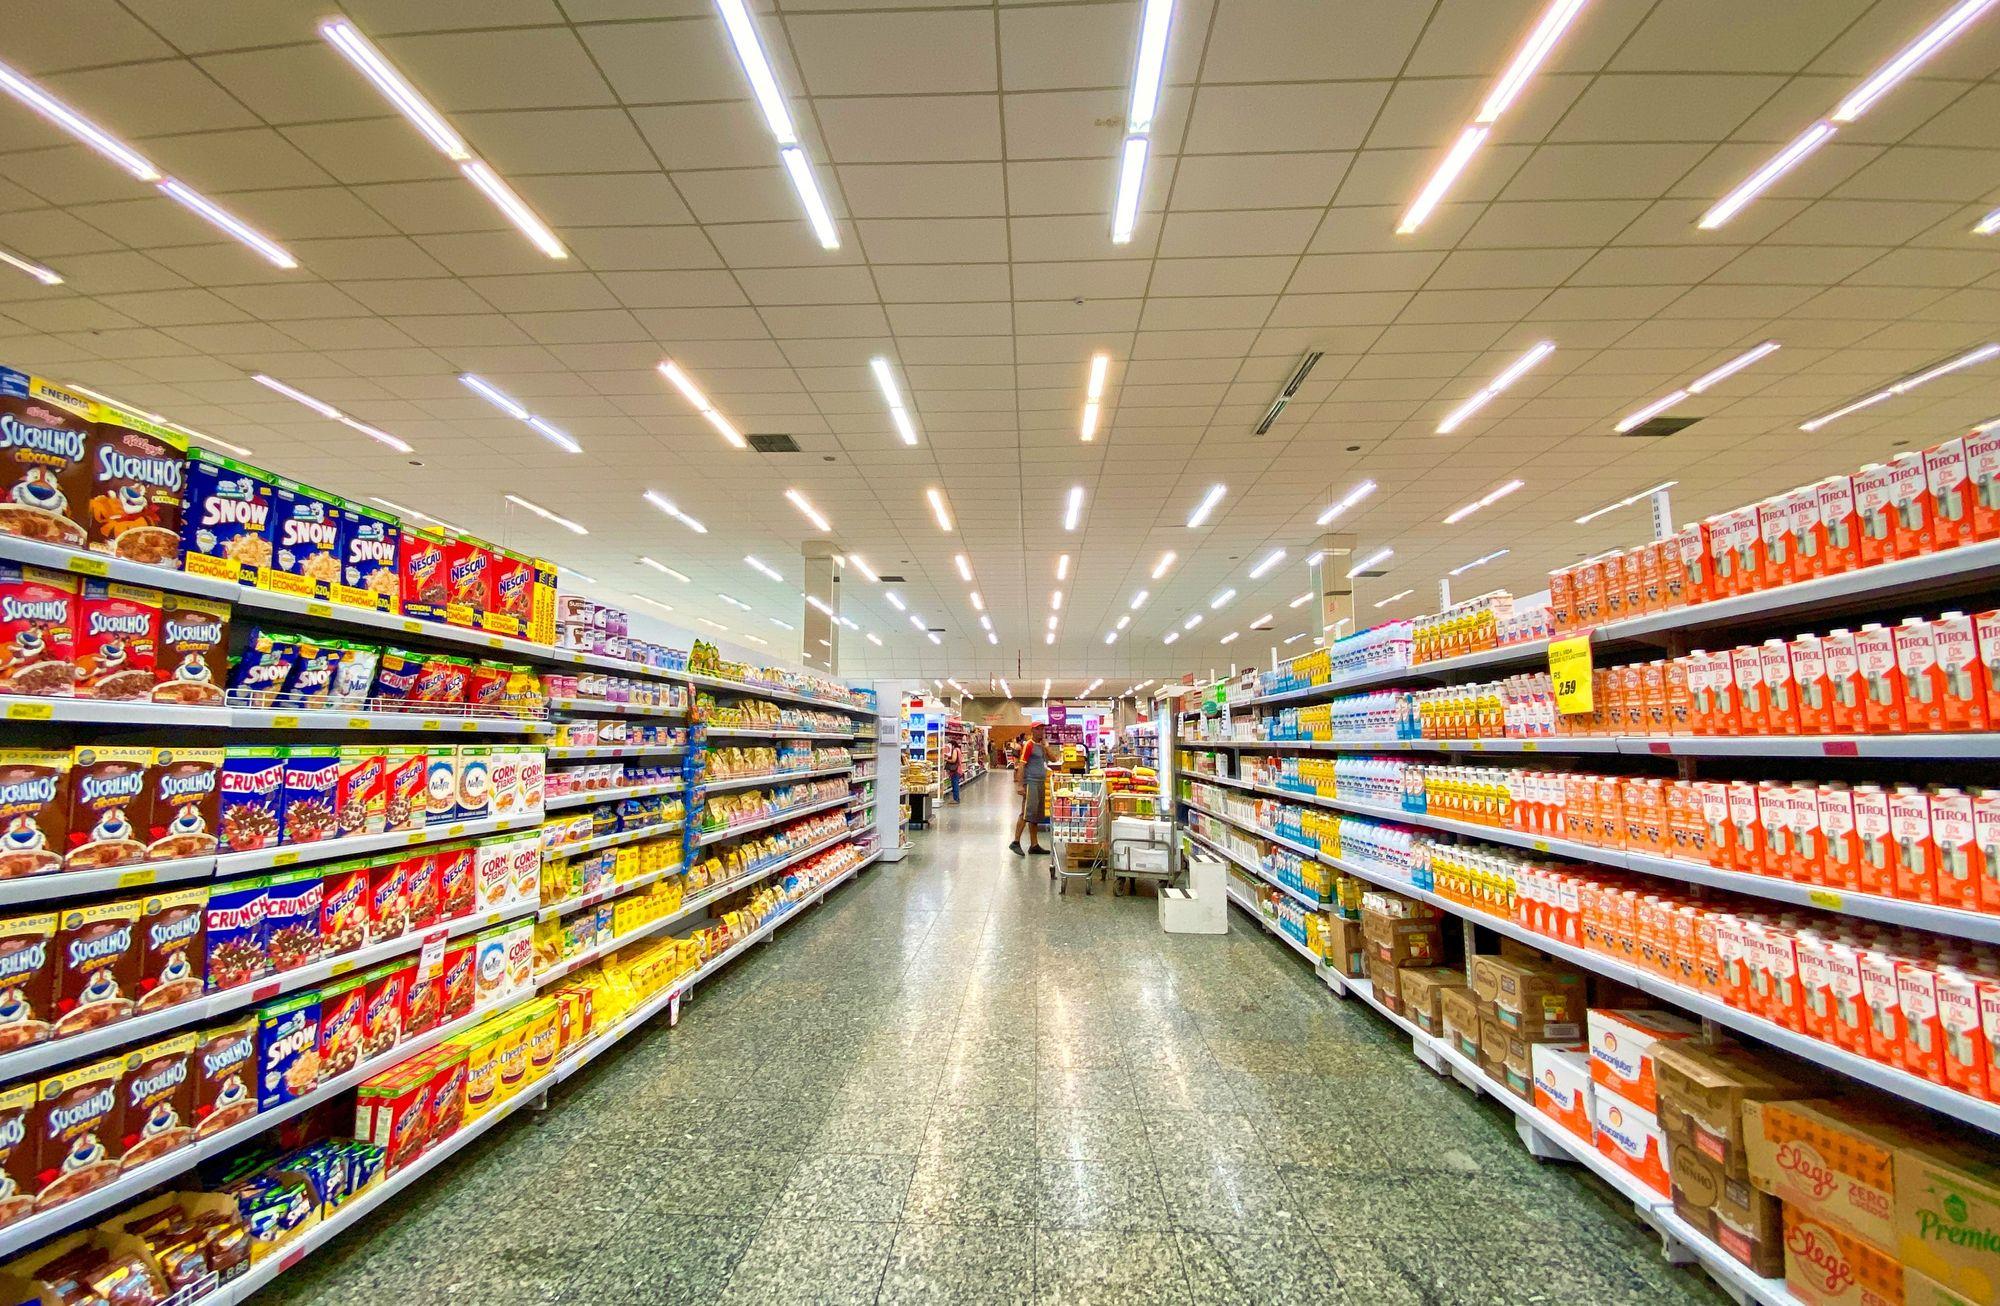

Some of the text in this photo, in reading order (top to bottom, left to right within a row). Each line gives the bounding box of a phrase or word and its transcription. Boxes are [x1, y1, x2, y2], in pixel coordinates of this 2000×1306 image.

[0, 416, 88, 462] SUCRILHOS
[99, 445, 185, 493] SUCRILHOS
[1926, 452, 1964, 471] TIROL
[1889, 466, 1922, 484] TIROL
[1820, 489, 1850, 505] TIROL
[1854, 478, 1889, 495] TIROL
[202, 499, 270, 526] SNOW
[1761, 509, 1786, 523] TIROL
[1788, 499, 1818, 516] TIROL
[283, 519, 338, 546] SNOW
[1711, 527, 1734, 540] TIROL
[1733, 518, 1757, 532] TIROL
[348, 538, 396, 564] SNOW
[1680, 535, 1701, 548] TIROL
[409, 549, 442, 576] NESCAU
[450, 555, 487, 582] NESCAU
[498, 570, 531, 595] NESCAU
[2, 596, 68, 624] SUCRILHOS
[89, 611, 151, 636] SUCRILHOS
[165, 620, 222, 645] SUCRILHOS
[1857, 642, 1891, 655] TIROL
[1897, 636, 1933, 650] TIROL
[1936, 631, 1972, 645] TIROL
[1763, 654, 1786, 666] TIROL
[1792, 651, 1822, 663] TIROL
[1824, 646, 1854, 659] TIROL
[243, 664, 293, 685] SNOW
[1708, 661, 1730, 672] TIROL
[1735, 659, 1758, 670] TIROL
[417, 671, 446, 695] NESCAU
[222, 767, 283, 792] CRUNCH
[285, 765, 339, 789] CRUNCH
[347, 764, 381, 792] NESCAU
[395, 761, 424, 788] NESCAU
[492, 764, 516, 782] CORN
[521, 763, 542, 780] CORN
[82, 770, 145, 802] SUCRILHOS
[161, 769, 216, 800] SUCRILHOS
[1704, 793, 1725, 805] TIROL
[1730, 794, 1756, 807] TIROL
[1761, 796, 1786, 809] TIROL
[1786, 799, 1816, 812] TIROL
[1819, 801, 1850, 814] TIROL
[1856, 803, 1886, 817] TIROL
[1891, 805, 1927, 820] TIROL
[1932, 808, 1971, 822] TIROL
[482, 854, 508, 876] CORN
[514, 848, 537, 869] CORN
[443, 855, 472, 889] NESCAU
[325, 876, 366, 921] NESCAU
[374, 870, 407, 908] NESCAU
[208, 895, 268, 930] CRUNCH
[267, 886, 323, 918] CRUNCH
[151, 911, 201, 950] SUCRILHOS
[1718, 928, 1741, 943] TIROL
[69, 925, 132, 970] SUCRILHOS
[509, 937, 530, 961] CORN
[1742, 936, 1766, 951] TIROL
[1766, 943, 1790, 959] TIROL
[444, 952, 473, 989] NESCAU
[1800, 952, 1825, 969] TIROL
[1828, 960, 1857, 978] TIROL
[1861, 969, 1895, 987] TIROL
[1899, 978, 1933, 997] TIROL
[366, 981, 400, 1025] NESCAU
[1940, 988, 1974, 1009] TIROL
[323, 996, 361, 1039] NESCAU
[267, 1023, 317, 1069] SNOW
[531, 1025, 557, 1047] Cheerios
[204, 1035, 252, 1079] SUCRILHOS
[501, 1042, 529, 1063] Cheerios
[468, 1059, 499, 1082] Cheerios
[131, 1057, 187, 1107] SUCRILHOS
[433, 1067, 465, 1110] NESCAU
[50, 1084, 115, 1138] SUCRILHOS
[396, 1086, 430, 1132] NESCAU
[1848, 1182, 1889, 1211] ZERO
